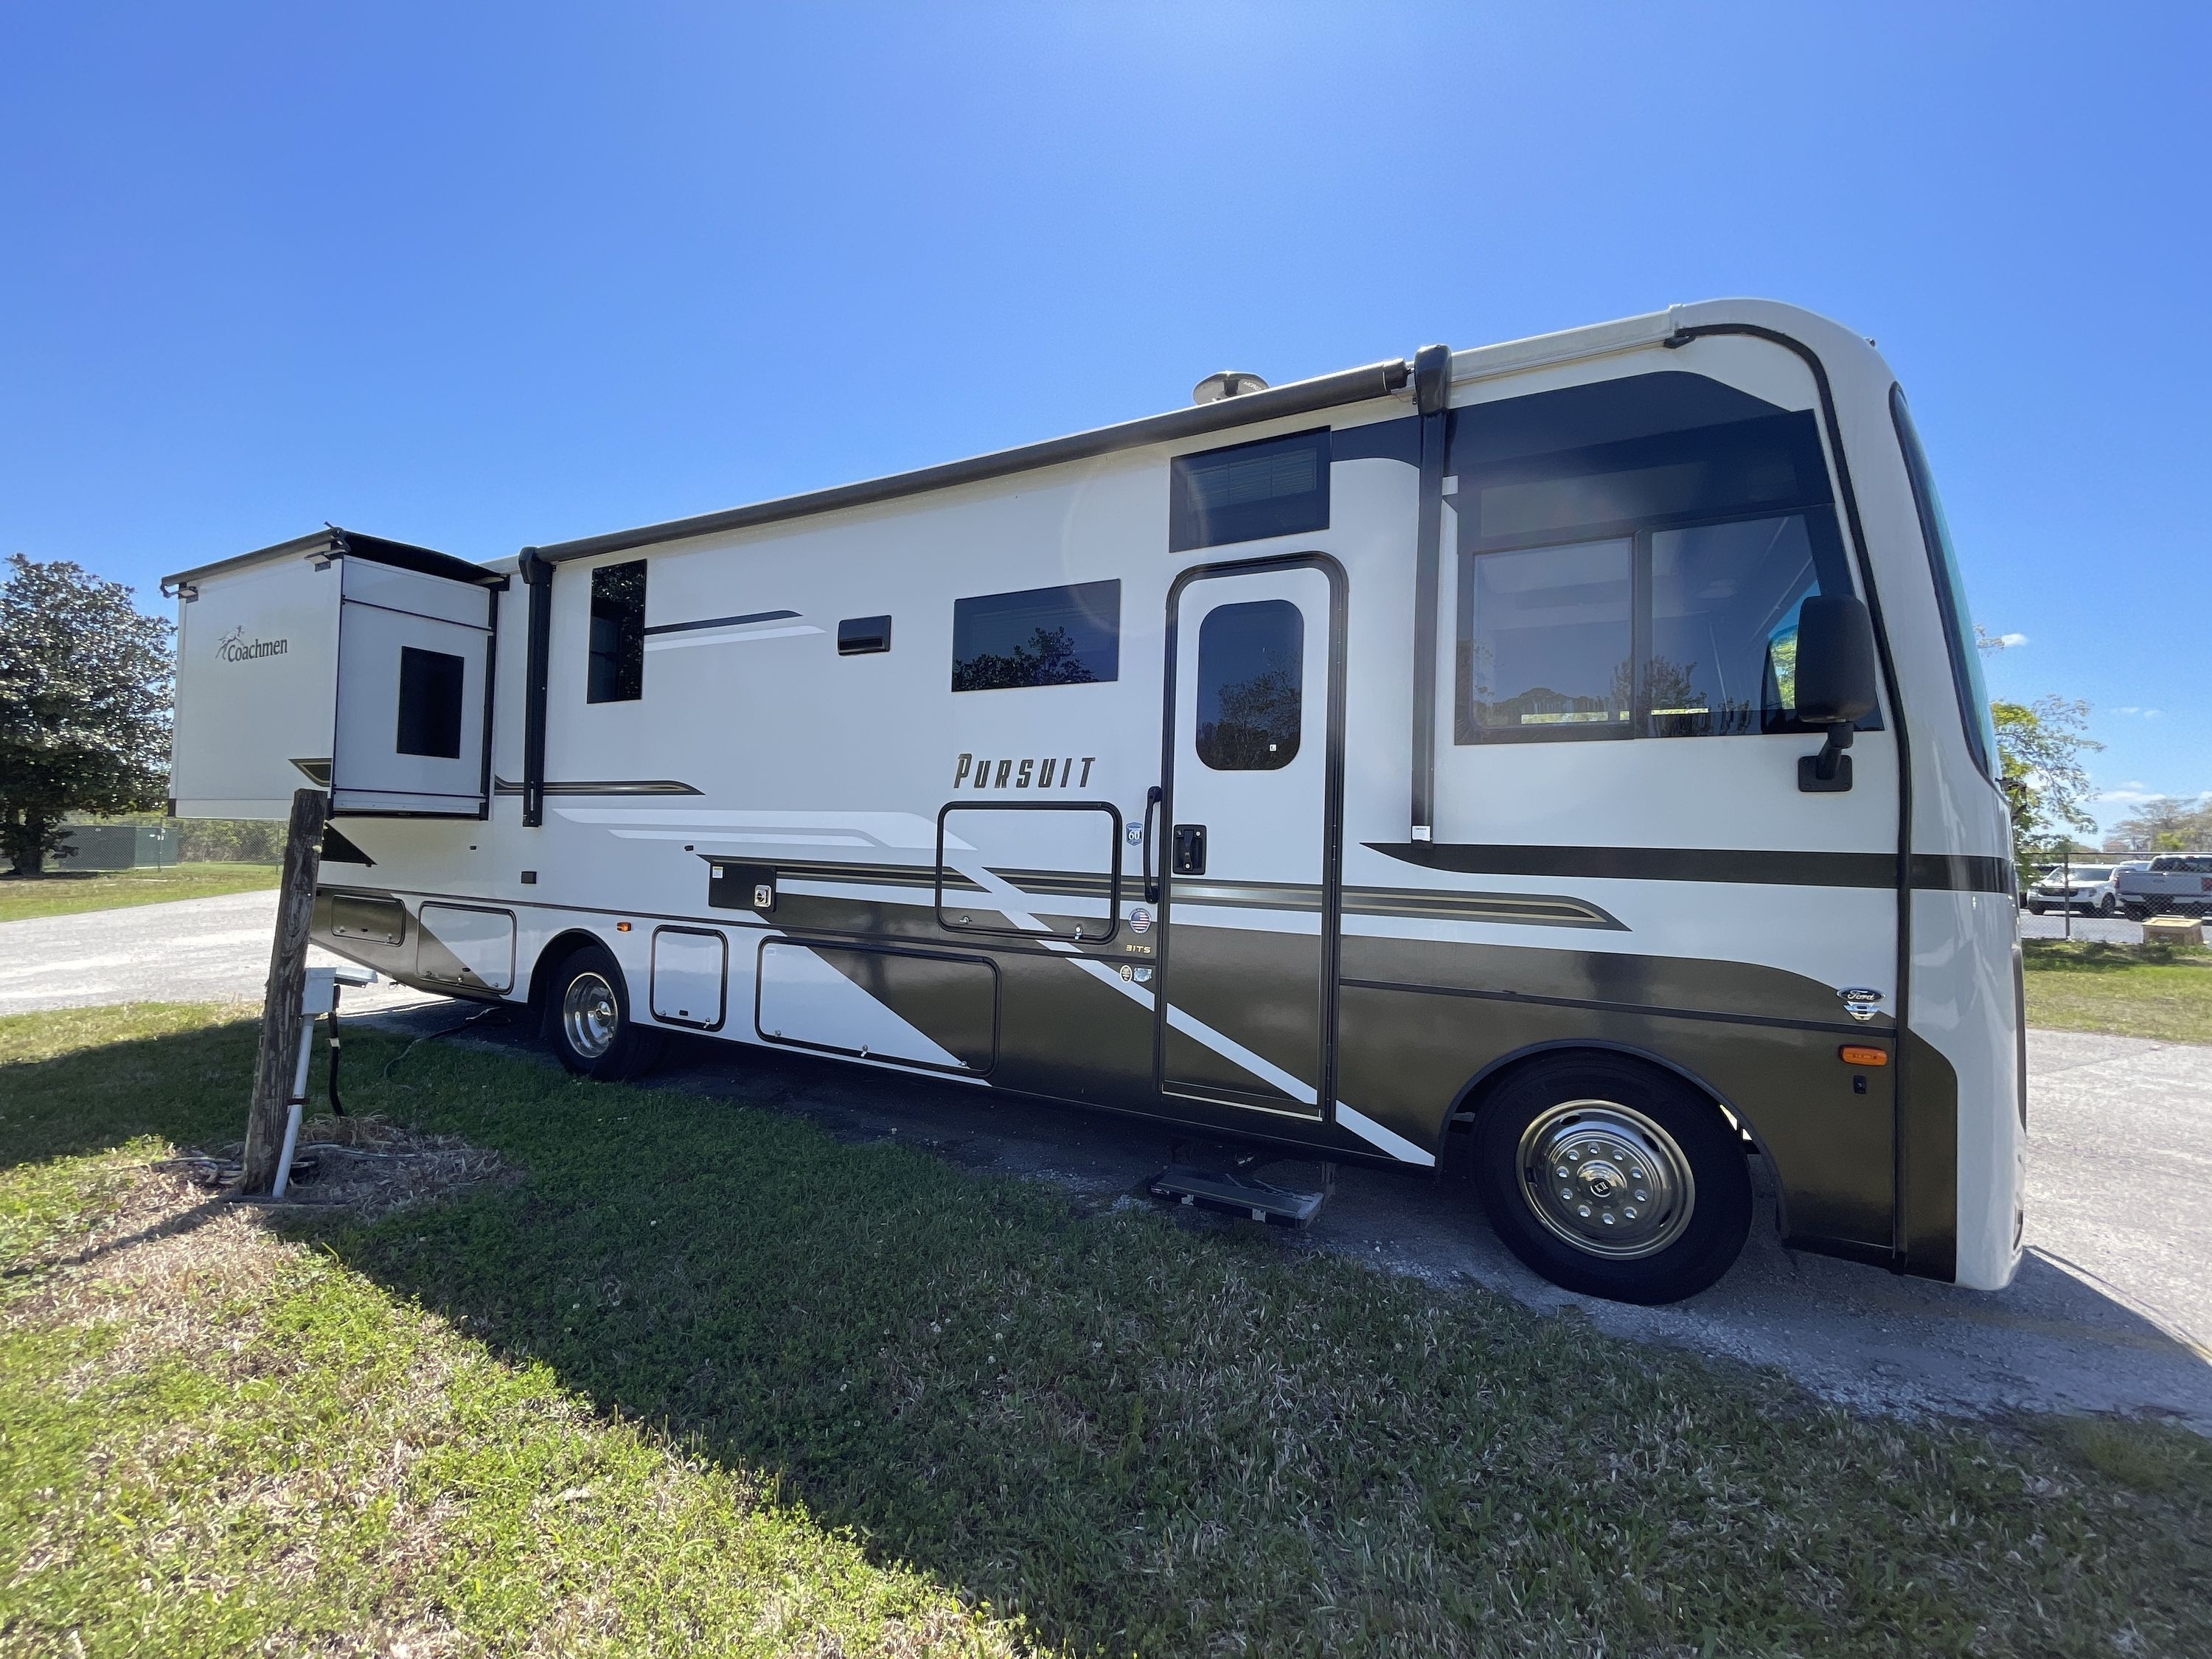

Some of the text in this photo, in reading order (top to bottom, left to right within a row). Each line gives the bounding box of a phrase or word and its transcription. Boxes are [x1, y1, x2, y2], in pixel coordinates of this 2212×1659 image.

[228, 639, 288, 662] Coachmen
[953, 754, 1096, 788] PURSUIT
[1128, 831, 1141, 840] 60
[1126, 945, 1151, 953] 31TS
[1847, 990, 1875, 1001] Ford
